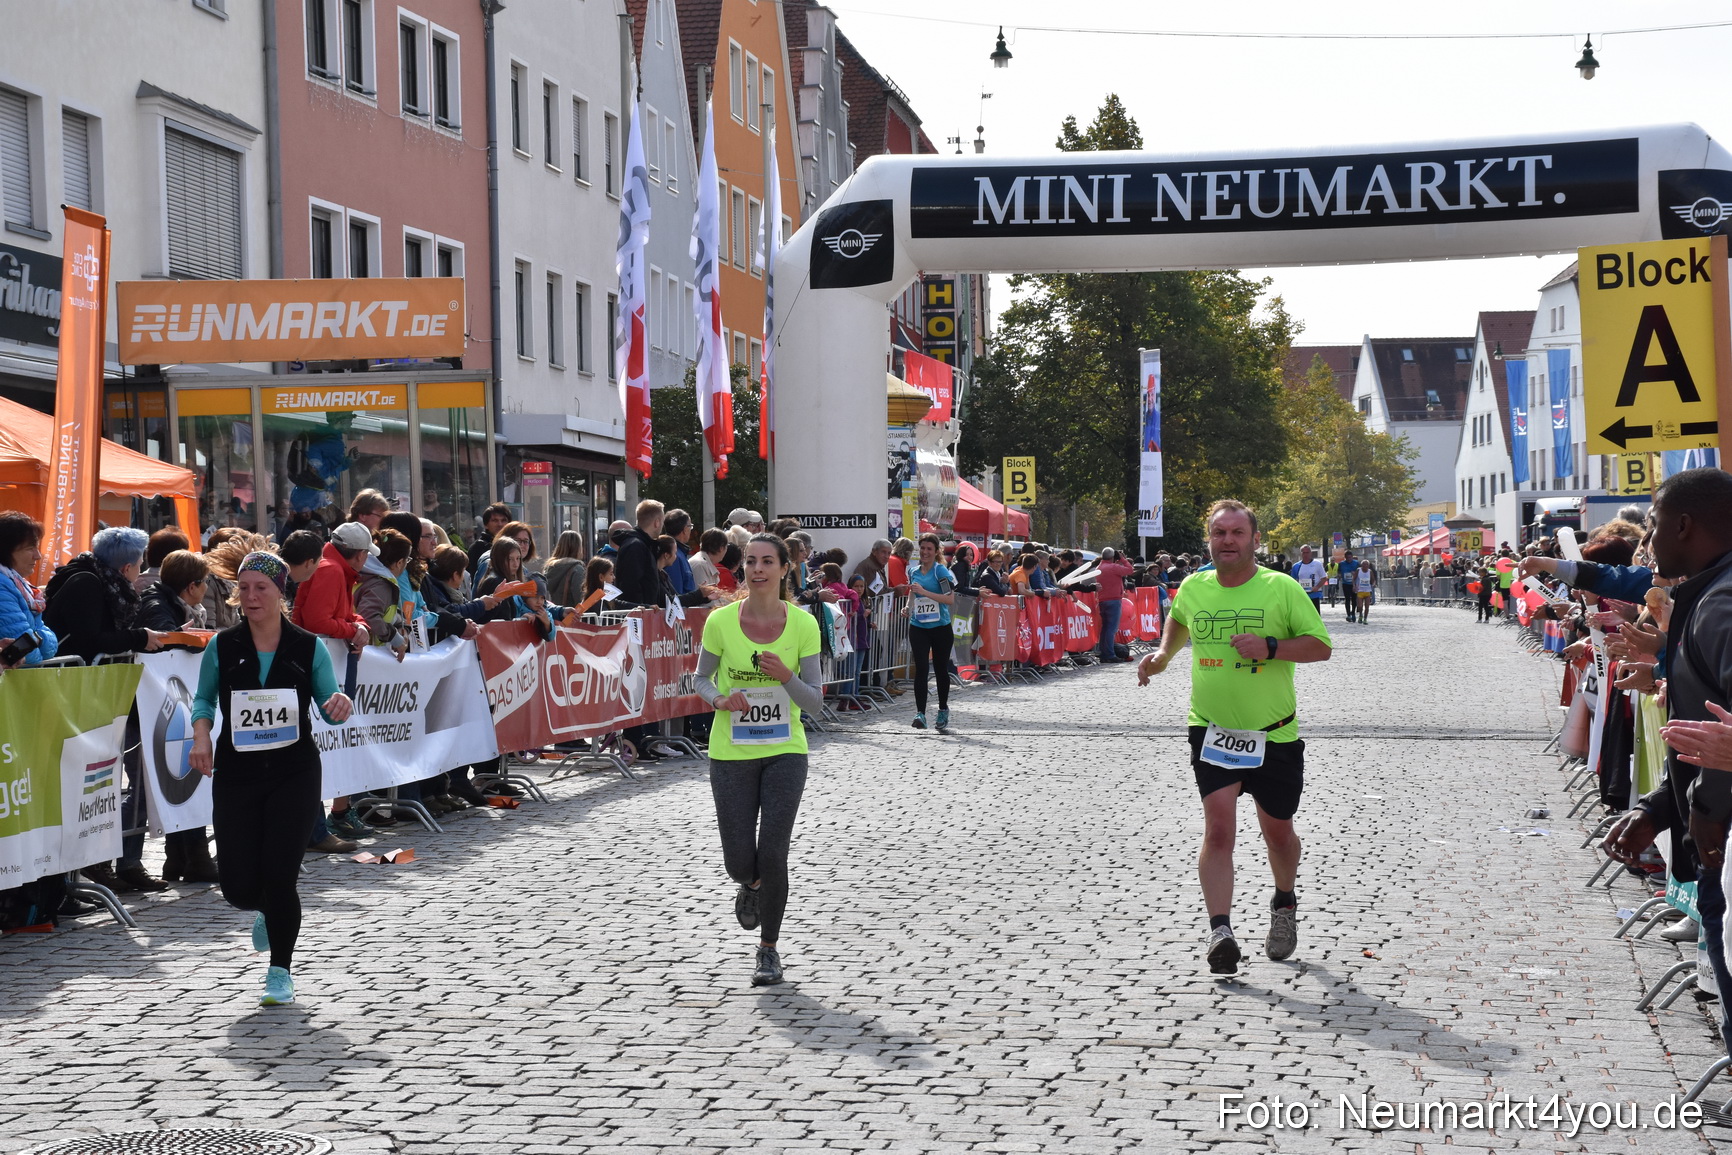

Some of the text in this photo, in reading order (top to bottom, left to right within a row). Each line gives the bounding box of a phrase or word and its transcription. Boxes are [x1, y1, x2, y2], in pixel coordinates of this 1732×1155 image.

[973, 154, 1566, 225] MINI NEUMARKT.
[1695, 208, 1718, 217] MINI
[841, 239, 862, 248] MINI
[1596, 247, 1711, 290] Block
[131, 300, 448, 343] RUNMARKT.DE
[1615, 304, 1701, 407] A
[275, 390, 396, 409] RUNMARKT.DE
[1007, 459, 1032, 467] Block
[1627, 460, 1645, 484] B
[1012, 471, 1028, 494] B
[918, 604, 936, 613] 2172
[240, 707, 288, 727] 2414
[255, 732, 278, 740] Andrea
[1213, 732, 1257, 753] 2090
[1224, 755, 1240, 763] Sepp
